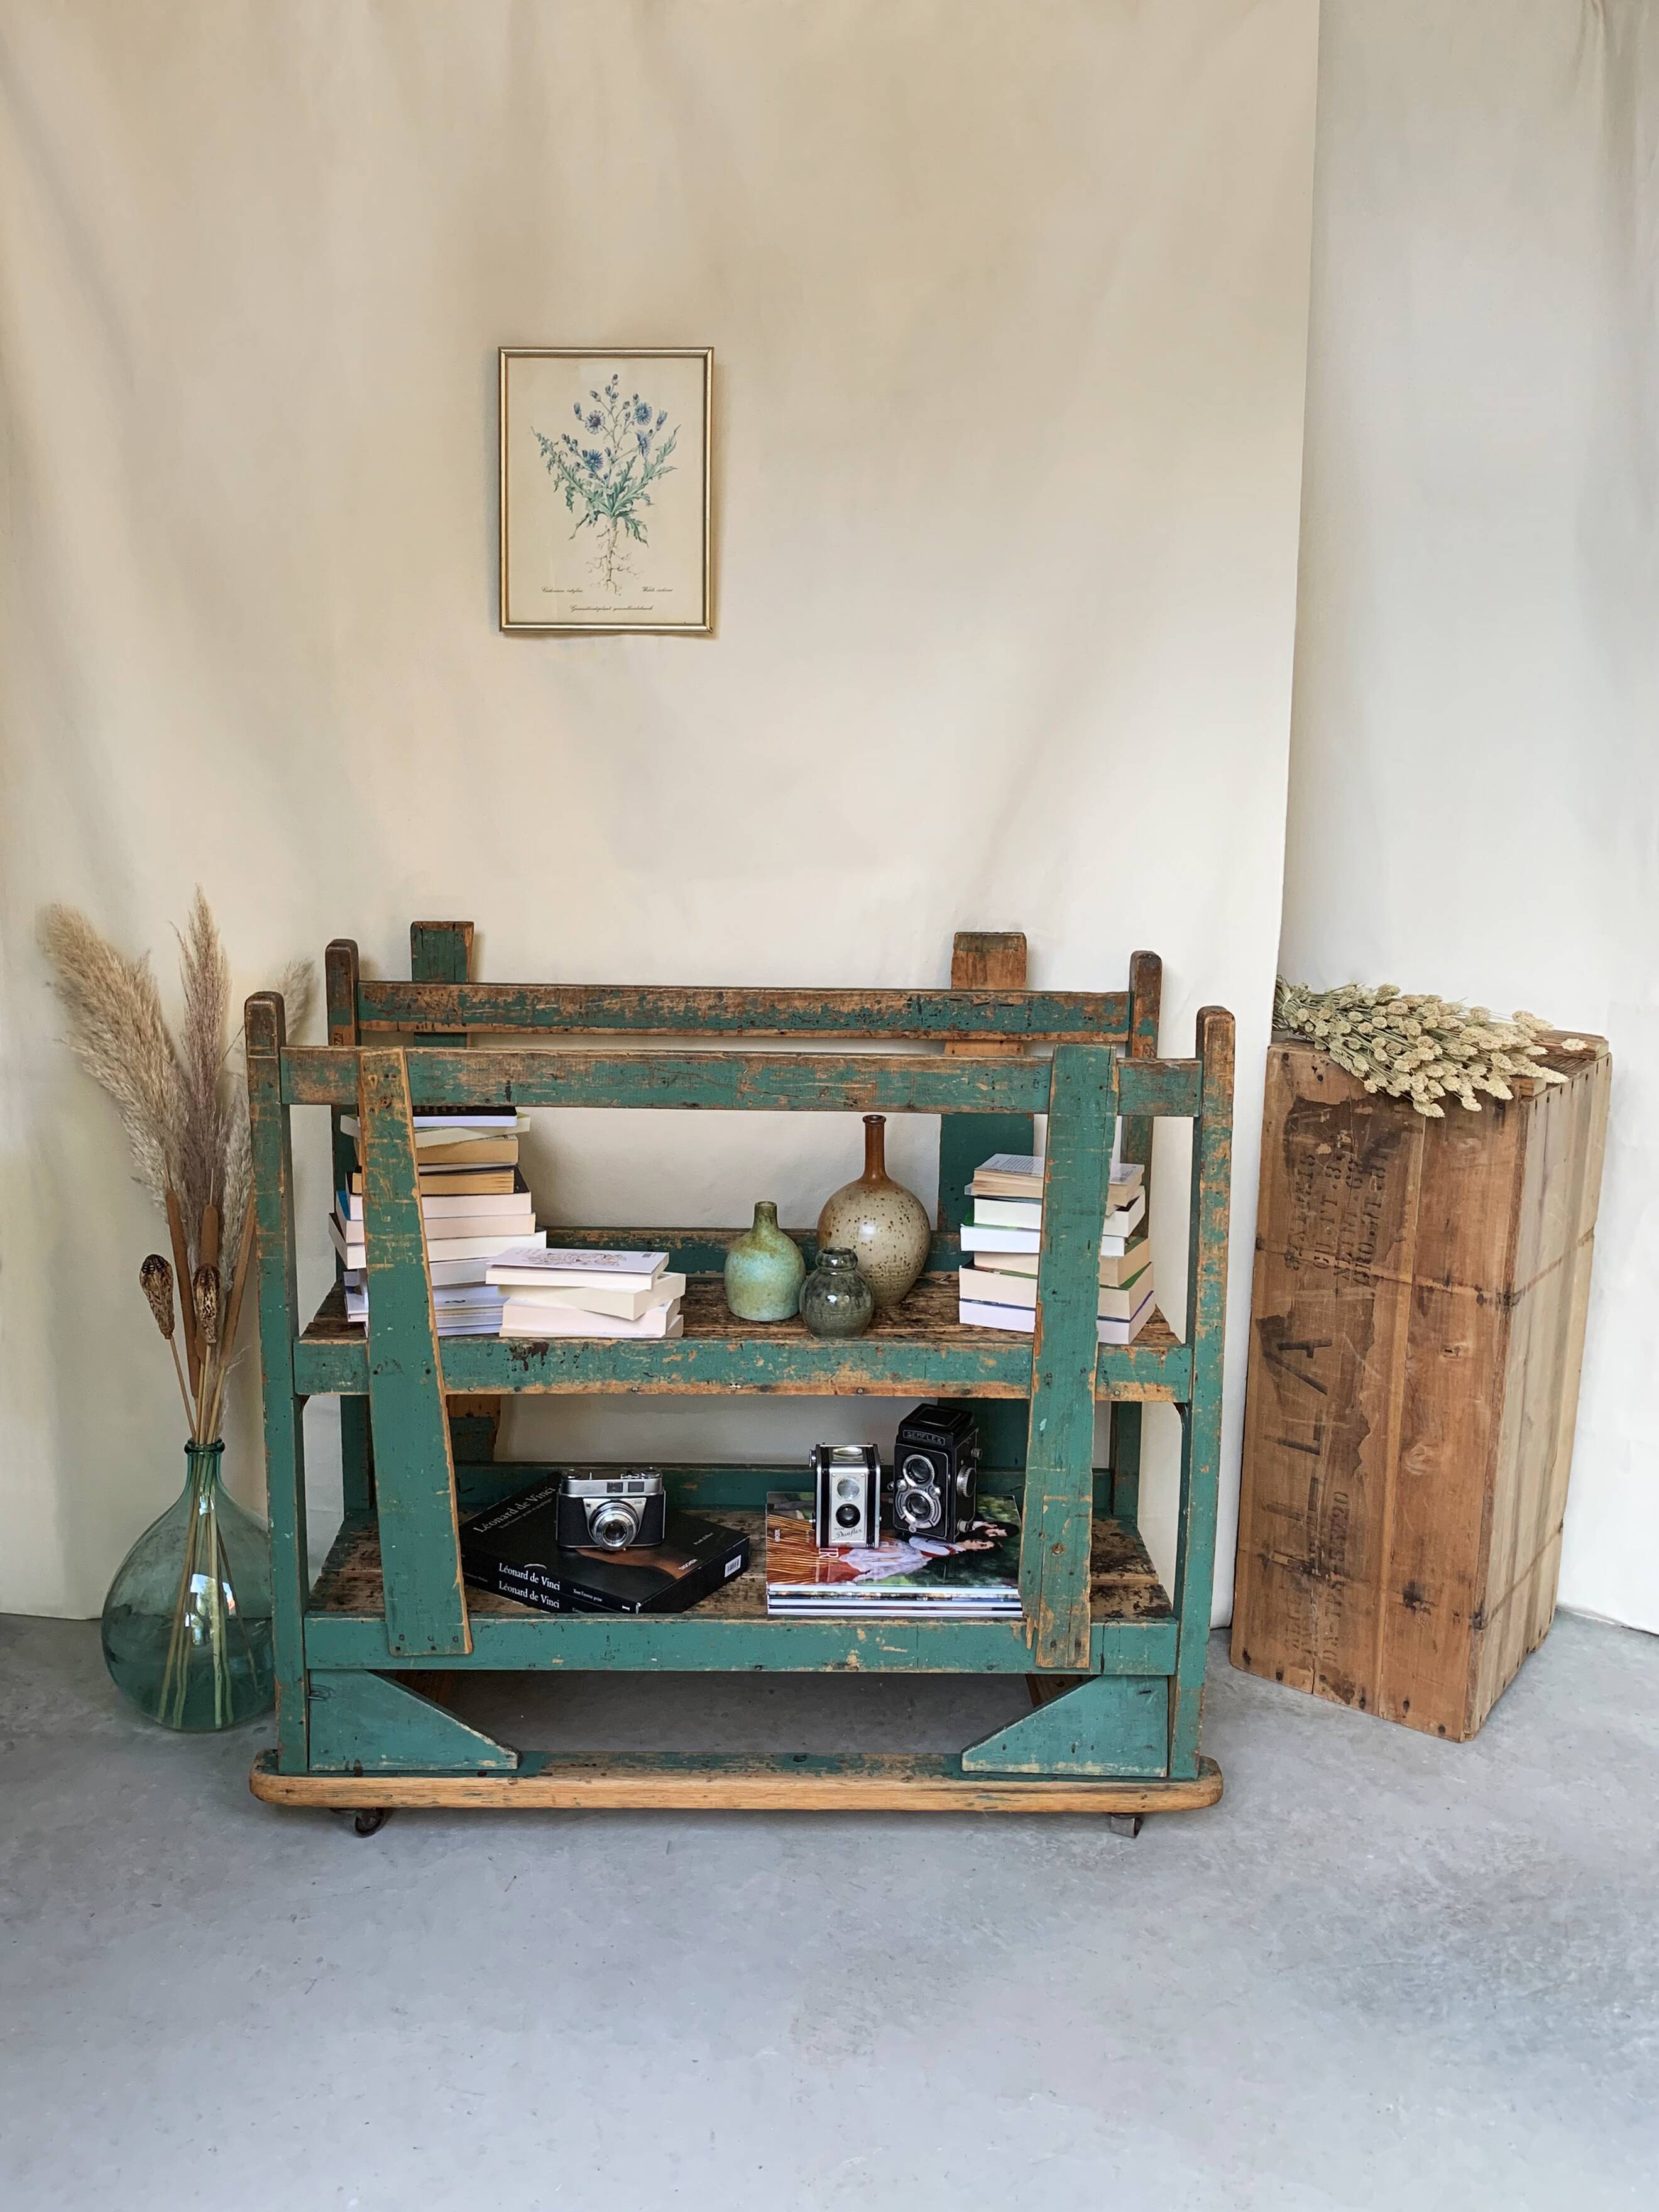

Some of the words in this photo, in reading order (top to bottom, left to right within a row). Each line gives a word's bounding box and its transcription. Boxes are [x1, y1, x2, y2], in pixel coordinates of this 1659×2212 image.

[906, 1432, 942, 1443] SEMFLEX
[473, 1508, 518, 1533] Léonard
[515, 1500, 531, 1510] de
[525, 1486, 556, 1503] Vinci
[836, 1528, 863, 1538] Duaflex
[499, 1563, 528, 1580] Léonard
[530, 1573, 539, 1584] de
[540, 1576, 561, 1591] Vinci
[498, 1580, 528, 1598] Léonard
[530, 1591, 539, 1601] de
[540, 1594, 560, 1609] Vinci
